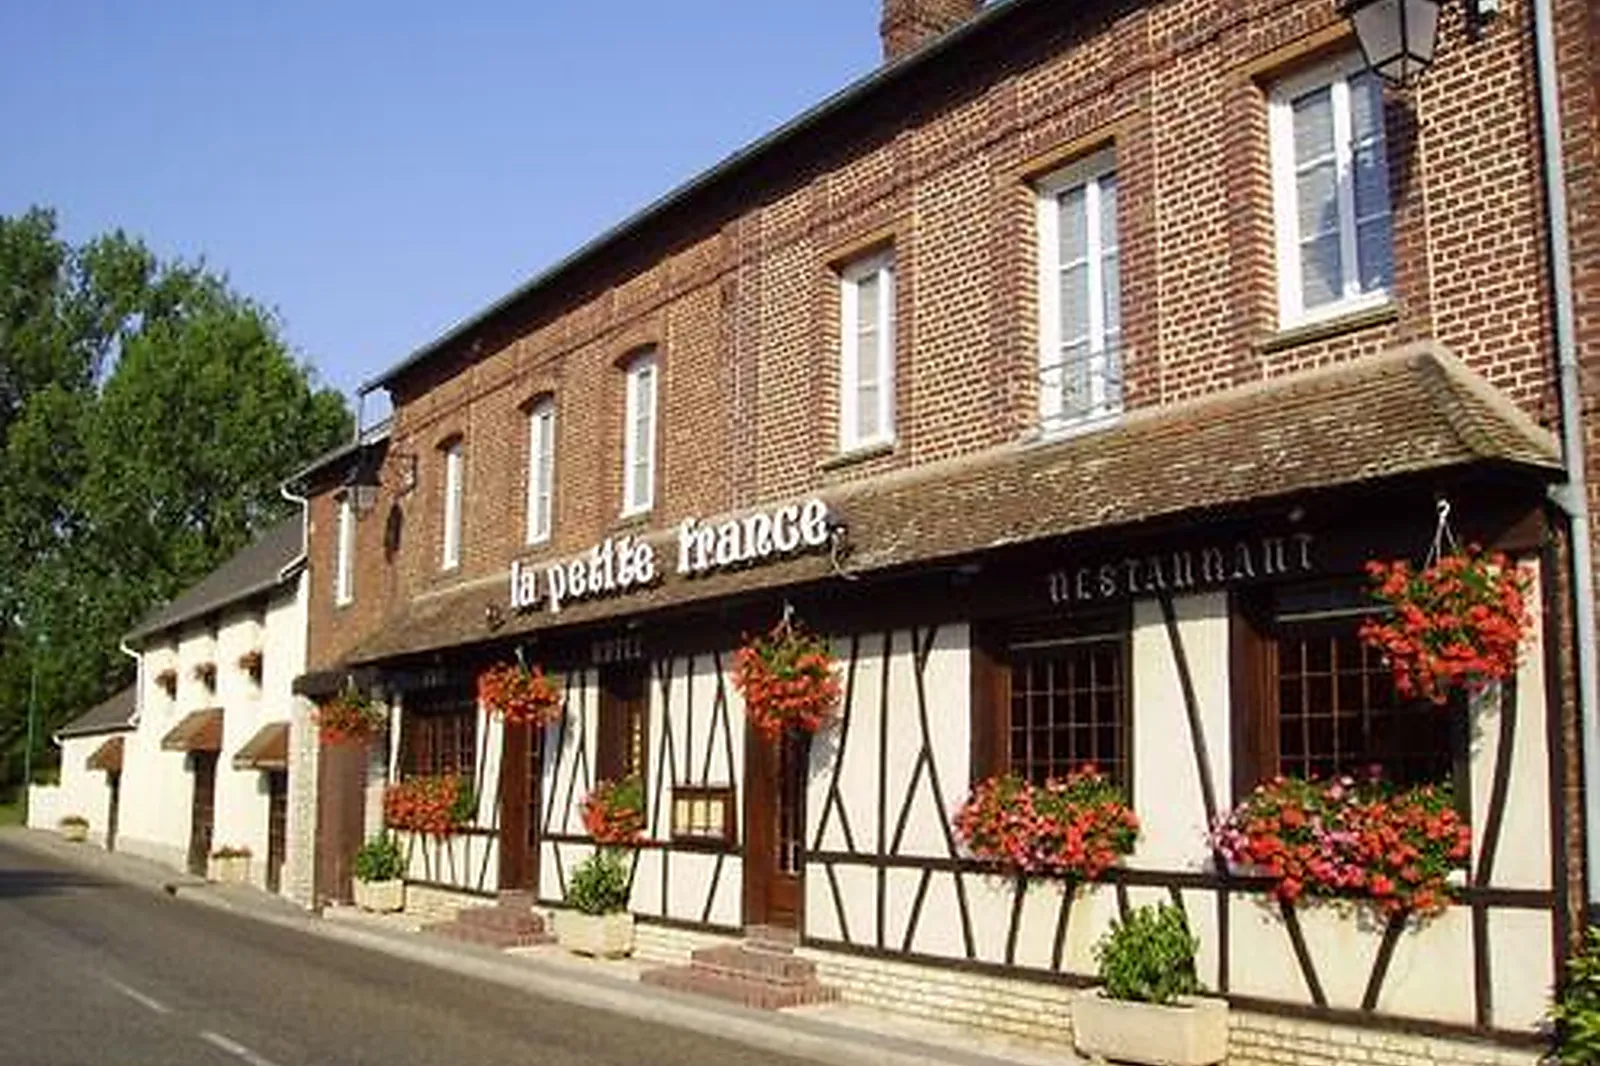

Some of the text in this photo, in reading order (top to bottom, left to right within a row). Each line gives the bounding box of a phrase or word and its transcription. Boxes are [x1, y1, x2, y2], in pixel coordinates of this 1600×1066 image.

[510, 498, 829, 613] la petite france
[1049, 534, 1313, 603] RESTAURANT
